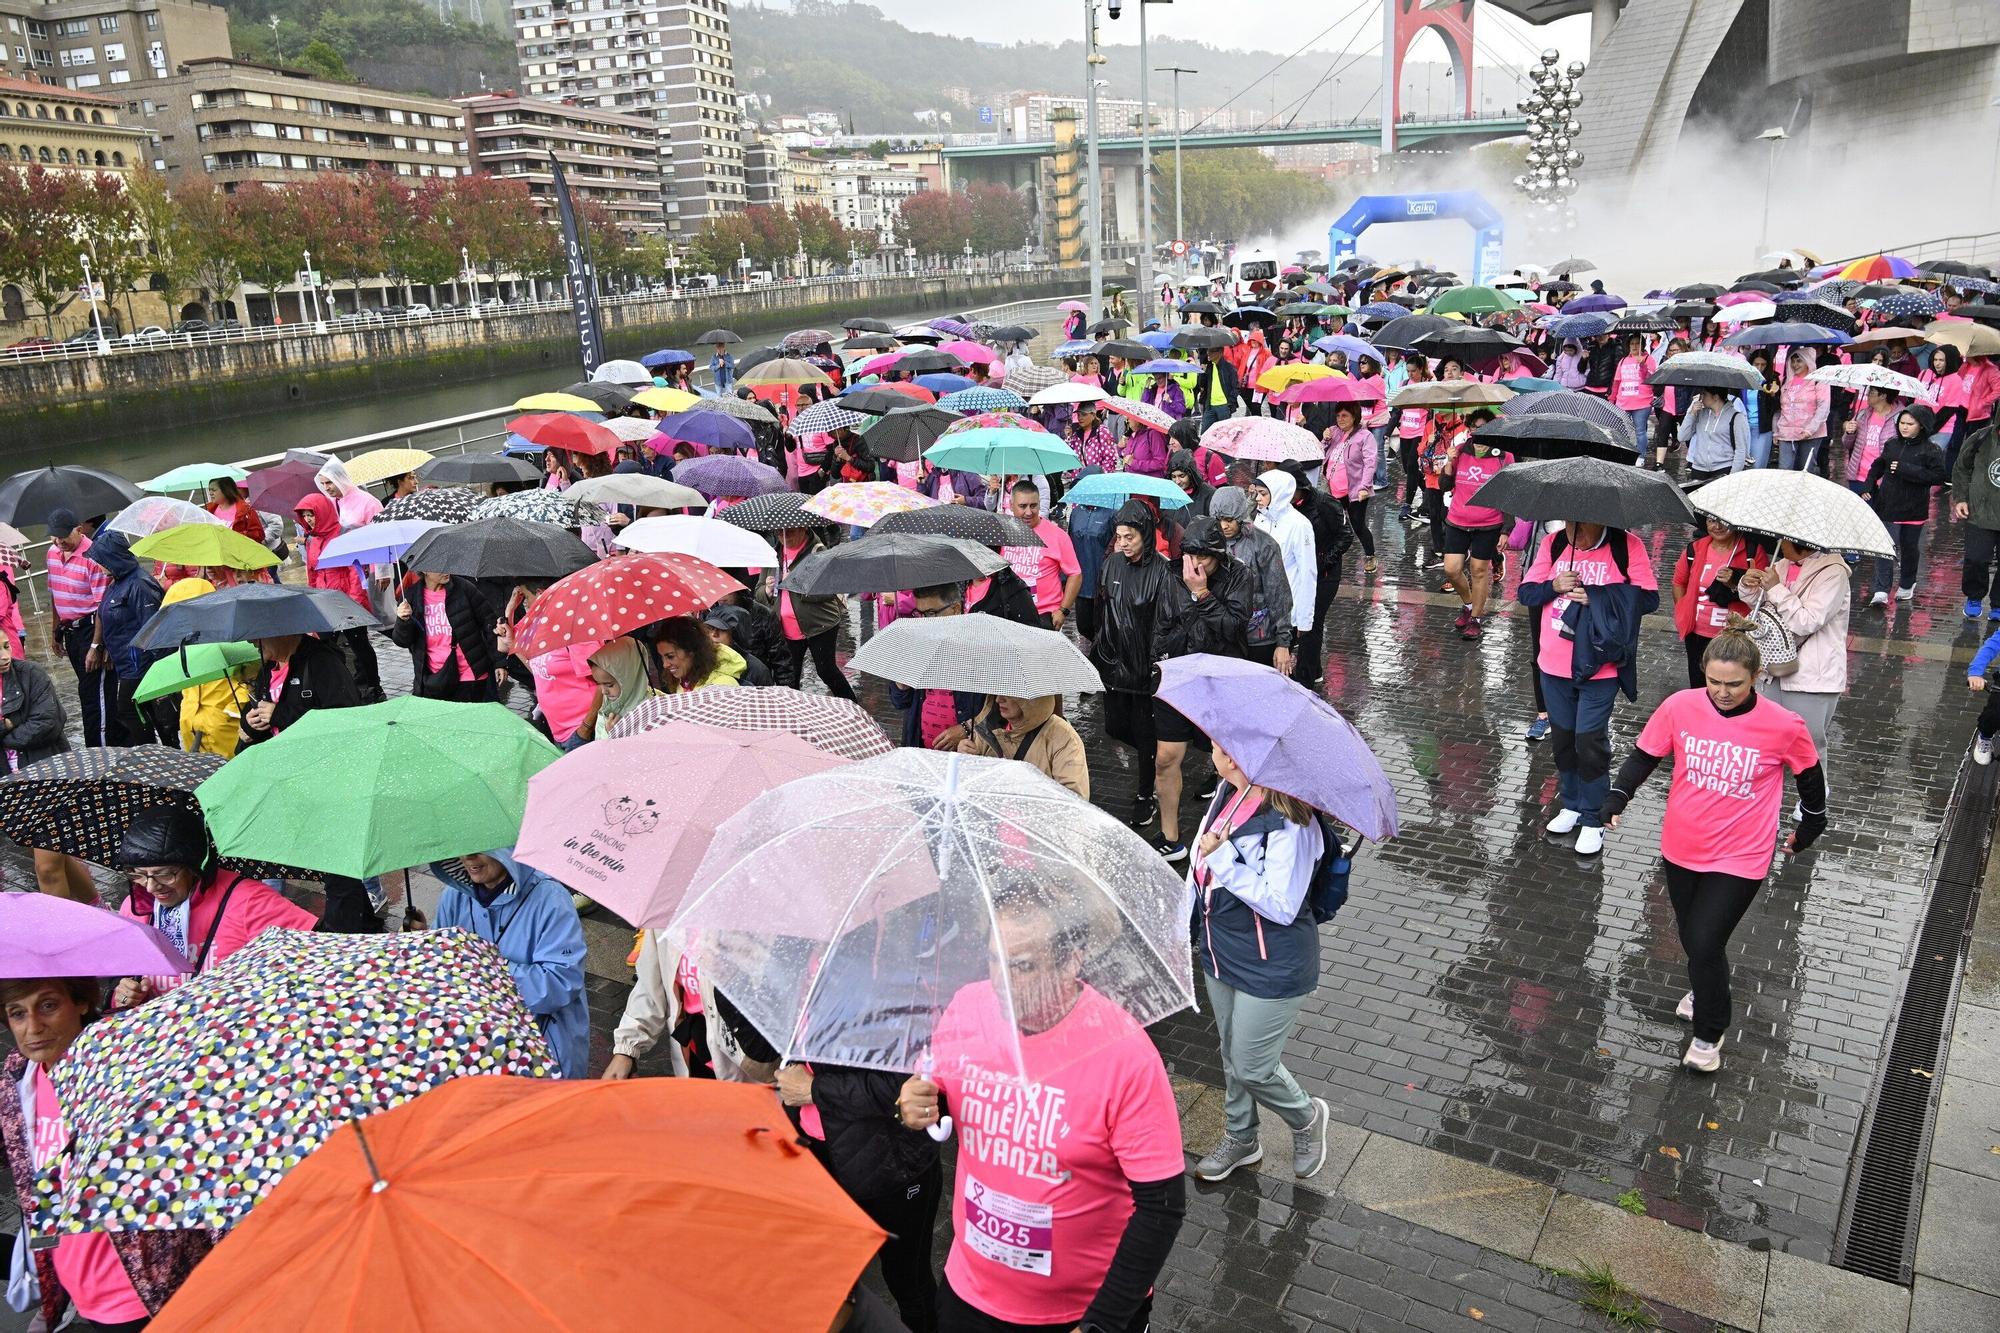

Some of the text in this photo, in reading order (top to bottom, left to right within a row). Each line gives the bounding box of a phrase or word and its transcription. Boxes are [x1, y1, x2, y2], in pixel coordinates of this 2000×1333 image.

[1687, 769, 1753, 798] AVANZA
[563, 836, 626, 873] in the rain
[591, 829, 627, 852] DANCING
[574, 860, 586, 872] my
[584, 866, 608, 882] cardio
[962, 1125, 1066, 1180] AVANZA
[976, 1209, 1031, 1247] 2025
